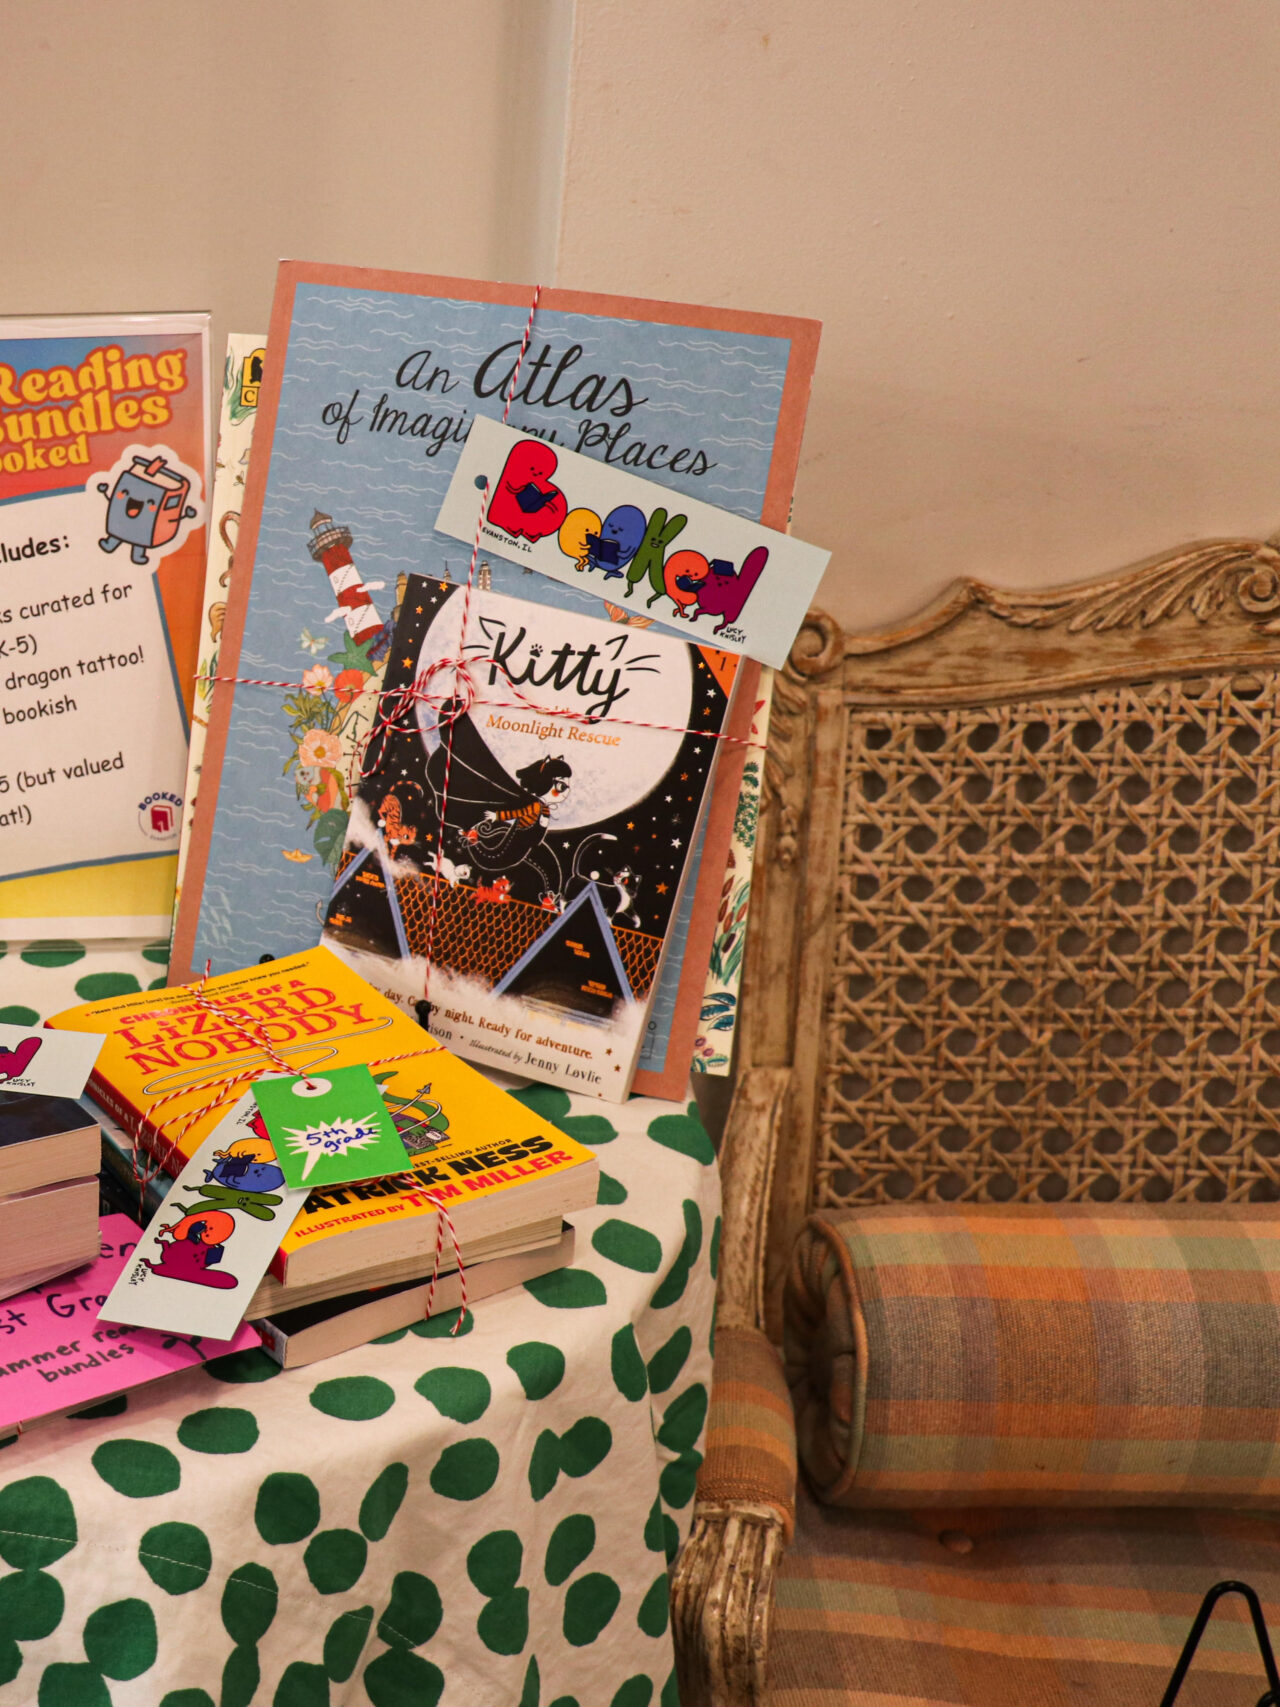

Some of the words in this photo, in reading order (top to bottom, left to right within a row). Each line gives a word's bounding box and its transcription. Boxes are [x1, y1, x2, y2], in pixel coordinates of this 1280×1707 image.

[394, 350, 460, 394] An
[473, 339, 649, 417] Atlas
[321, 389, 365, 445] of
[577, 419, 719, 476] Places
[19, 590, 95, 621] curated
[100, 582, 133, 608] for
[4, 662, 72, 693] dragon
[76, 645, 146, 677] tattoo!
[487, 627, 630, 725] Kitty
[2, 694, 78, 727] bookish
[485, 714, 564, 740] Moonlight
[566, 726, 622, 747] Rescue
[16, 768, 57, 795] (but
[63, 751, 125, 781] valued
[138, 791, 183, 811] BOOKED
[256, 983, 284, 996] OF
[288, 979, 307, 989] A
[124, 1002, 377, 1076] NOBODY
[383, 988, 404, 1005] day.
[444, 1008, 475, 1026] night.
[478, 1016, 511, 1038] Ready
[514, 1028, 533, 1043] for
[535, 1035, 593, 1059] adventure.
[523, 1052, 561, 1075] Jenny
[305, 1127, 346, 1146] 5th
[324, 1127, 378, 1152] grade
[413, 1150, 473, 1168] EST-SELLING
[474, 1138, 512, 1153] AUTHOR
[447, 1135, 554, 1176] NESS
[294, 1209, 386, 1238] ILLUSTRATED
[387, 1204, 406, 1214] BY
[462, 1149, 574, 1193] MILLER
[36, 1342, 136, 1384] bundles
